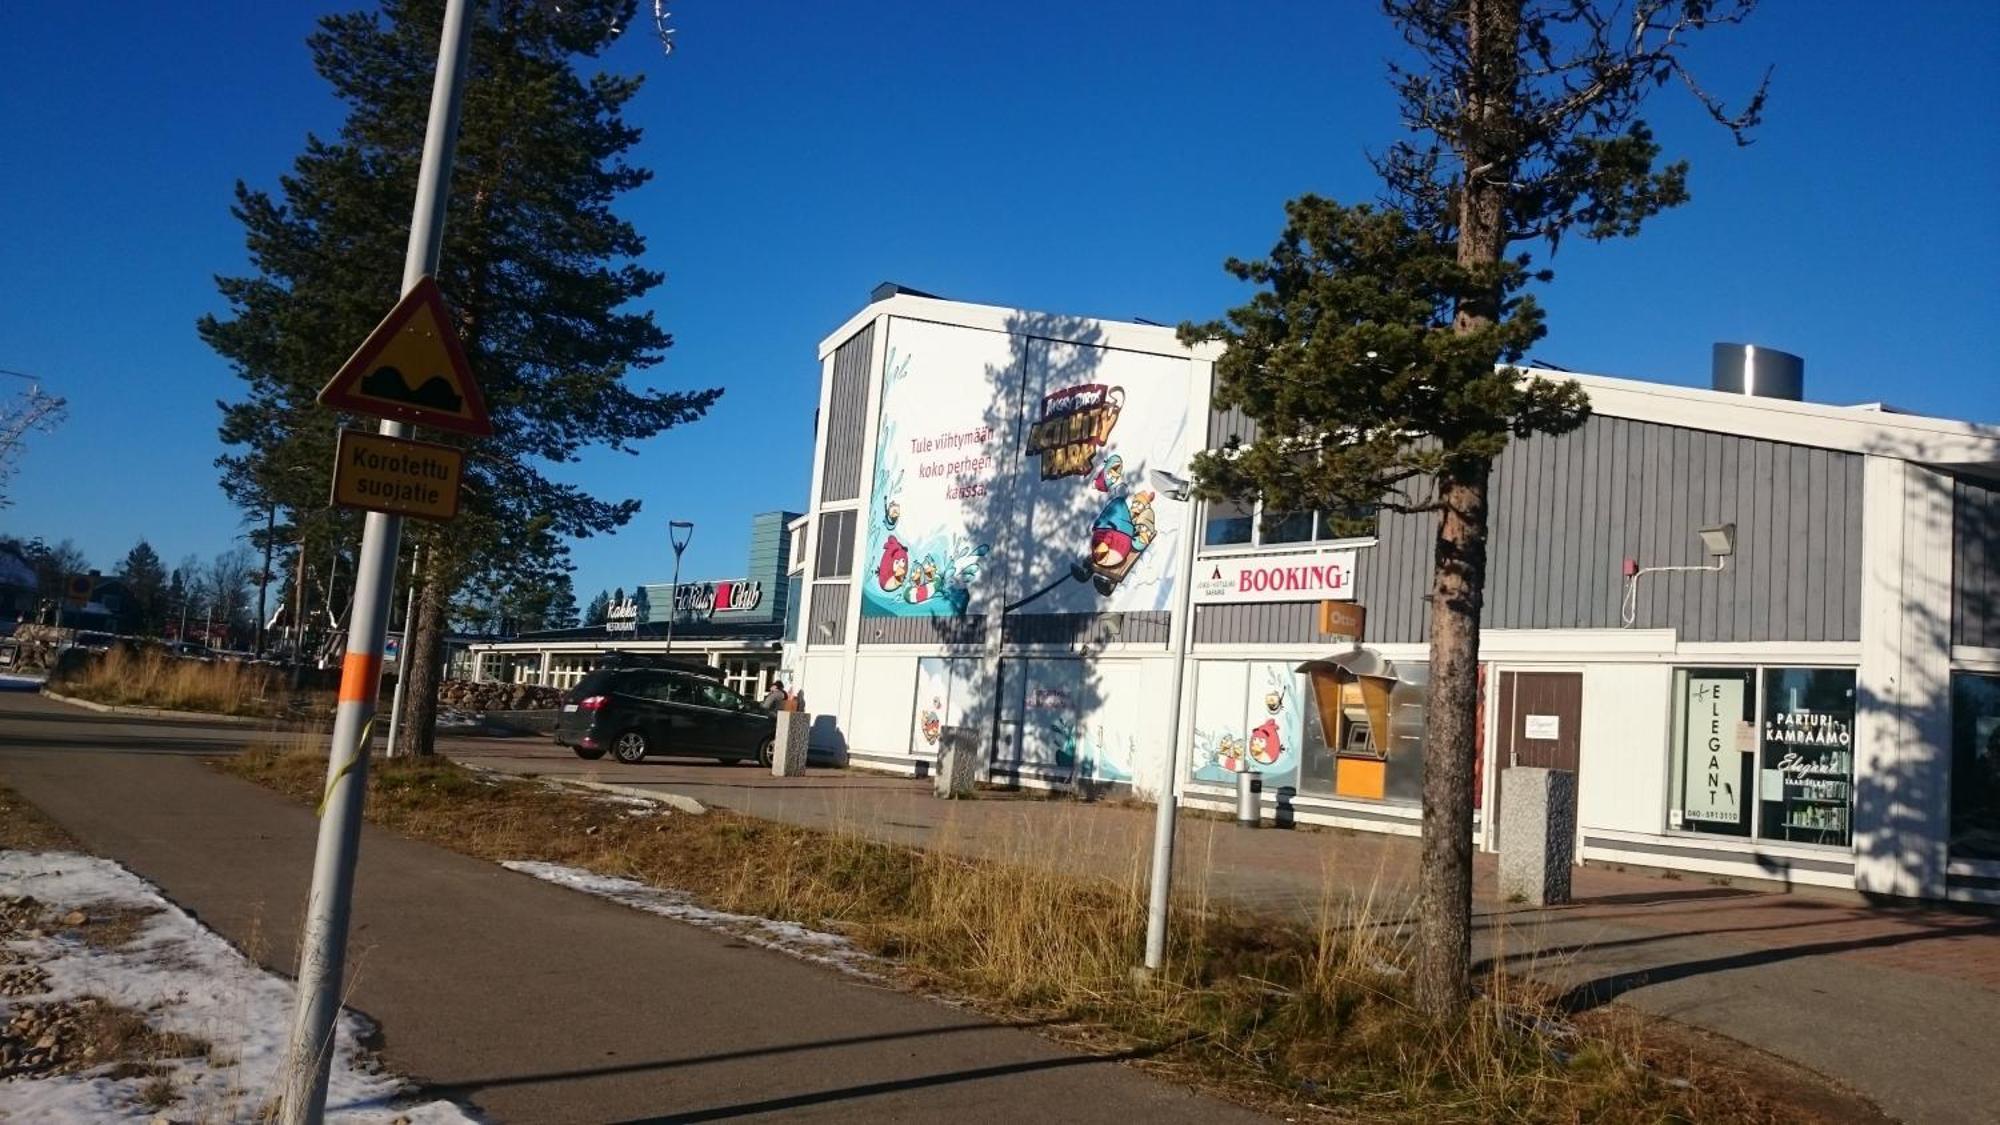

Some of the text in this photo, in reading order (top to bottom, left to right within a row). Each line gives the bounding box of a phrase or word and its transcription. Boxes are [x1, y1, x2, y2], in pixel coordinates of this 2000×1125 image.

[911, 426, 994, 454] Tule viihtymään
[353, 448, 448, 480] Korotettu
[919, 456, 992, 478] koko perheen
[1042, 442, 1096, 478] PARK
[357, 479, 438, 503] suojatie
[1239, 565, 1342, 592] BOOKING
[673, 581, 761, 617] Holiday Club
[1708, 685, 1721, 806] ELEGANT
[1766, 729, 1850, 745] KAMPAAMO
[1777, 753, 1838, 779] Elegant
